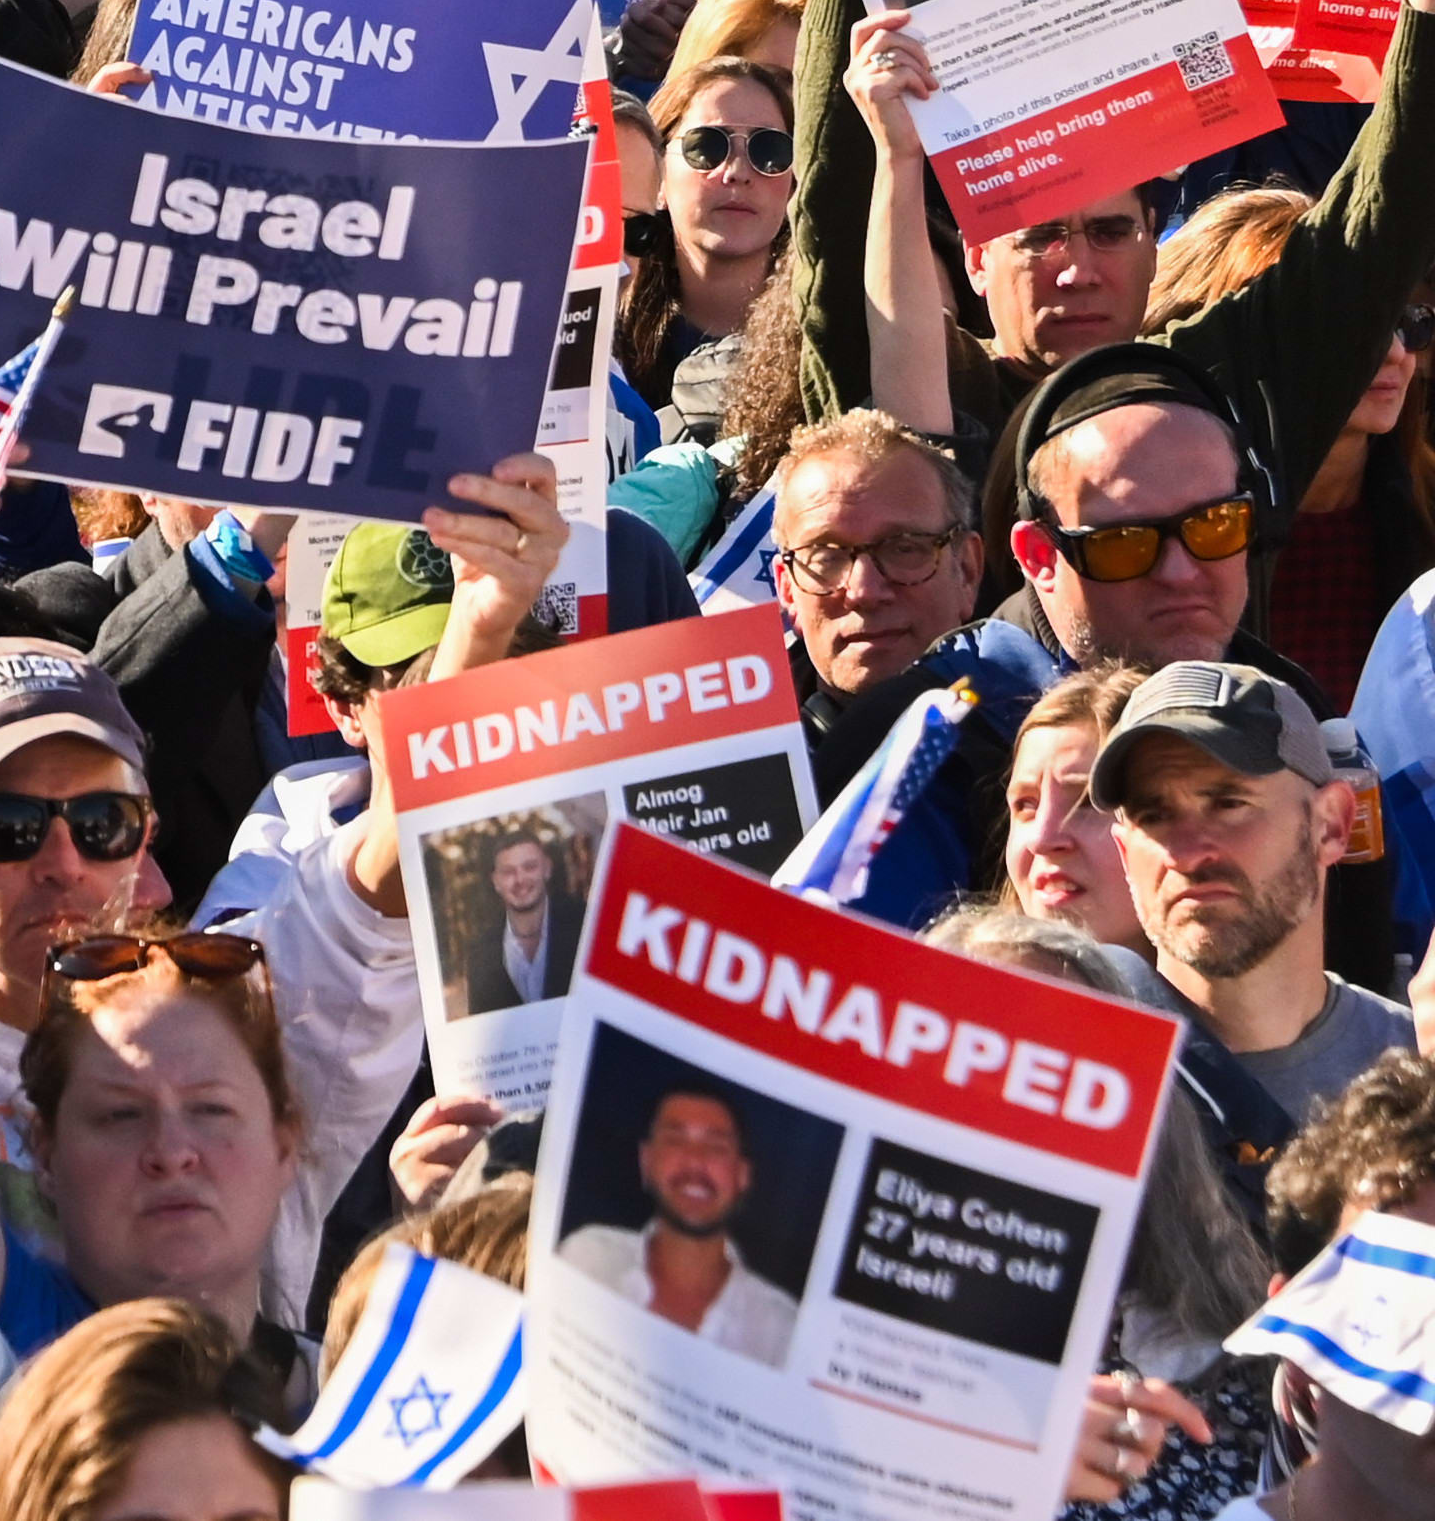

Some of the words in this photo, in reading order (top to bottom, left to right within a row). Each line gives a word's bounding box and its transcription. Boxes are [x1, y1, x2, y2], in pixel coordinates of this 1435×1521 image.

[140, 29, 344, 111] AGAINST
[129, 153, 414, 262] Israel
[184, 253, 523, 358] Prevail
[177, 398, 364, 487] FIDF
[407, 652, 772, 781] KIDNAPPED
[617, 893, 1131, 1132] KIDNAPPED
[875, 1167, 954, 1222] Eliya
[960, 1198, 1068, 1254] Cohen
[856, 1247, 954, 1304] Israeli
